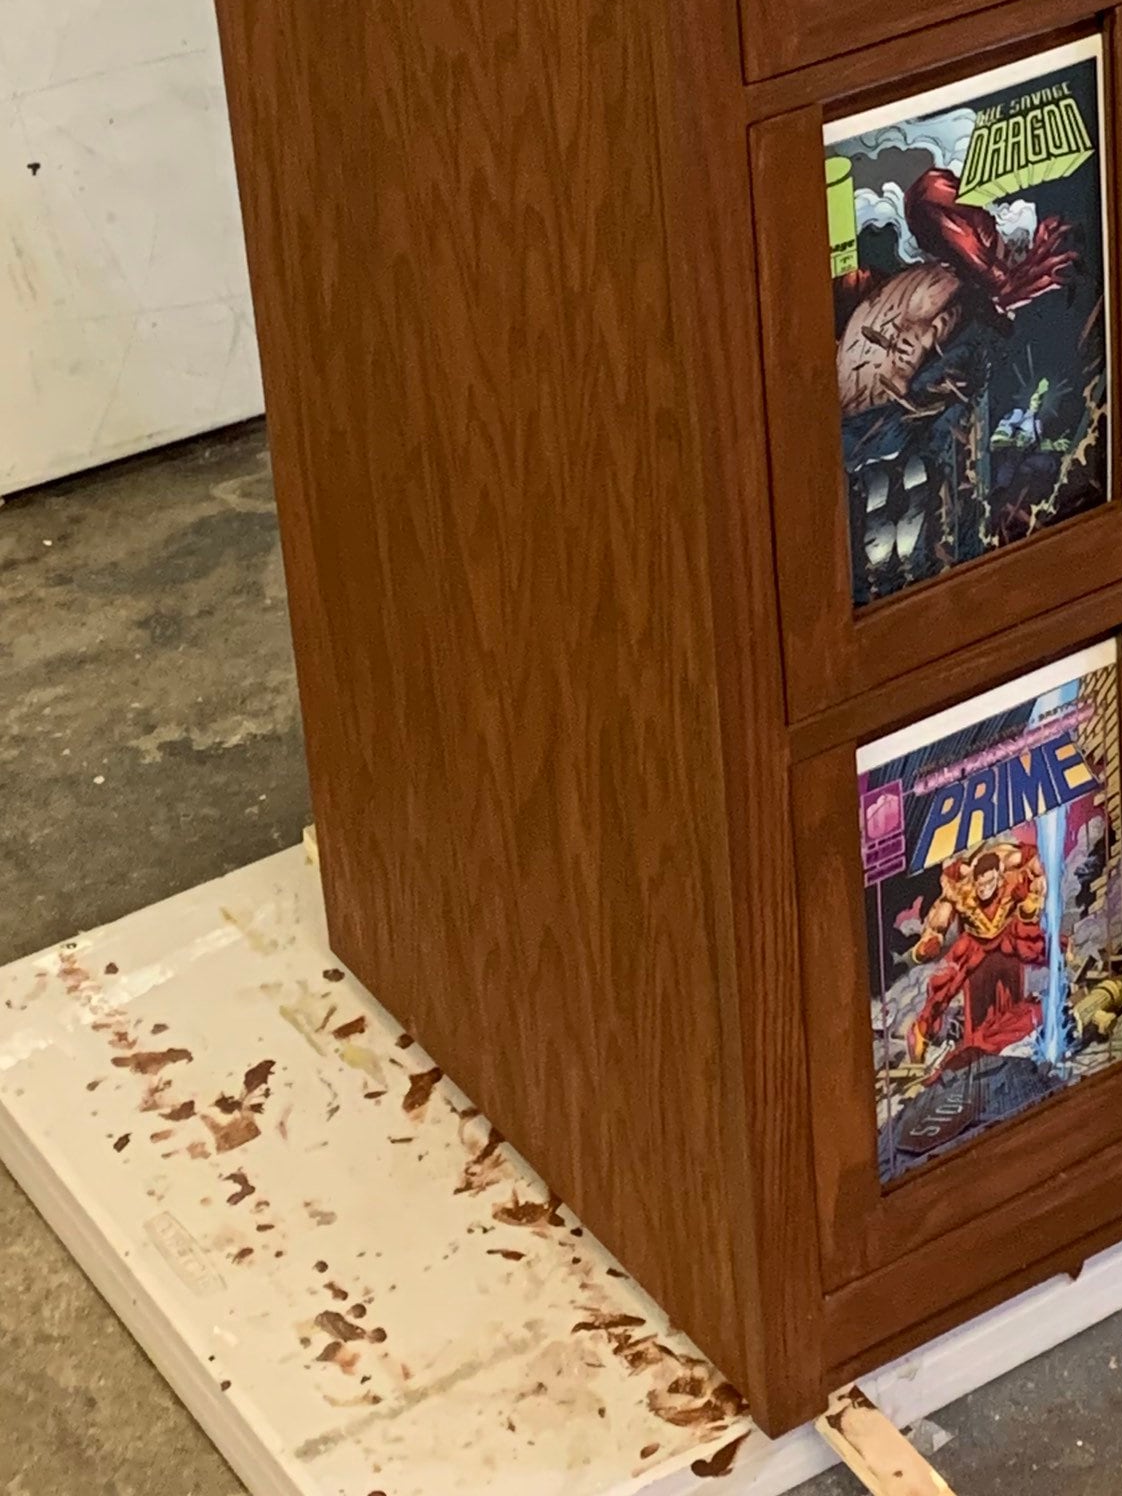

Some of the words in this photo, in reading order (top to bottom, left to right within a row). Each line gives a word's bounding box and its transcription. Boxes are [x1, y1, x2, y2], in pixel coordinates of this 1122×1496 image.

[956, 97, 1094, 200] DRAGON
[1009, 81, 1073, 116] SAVAGE
[909, 732, 1100, 878] PRIME
